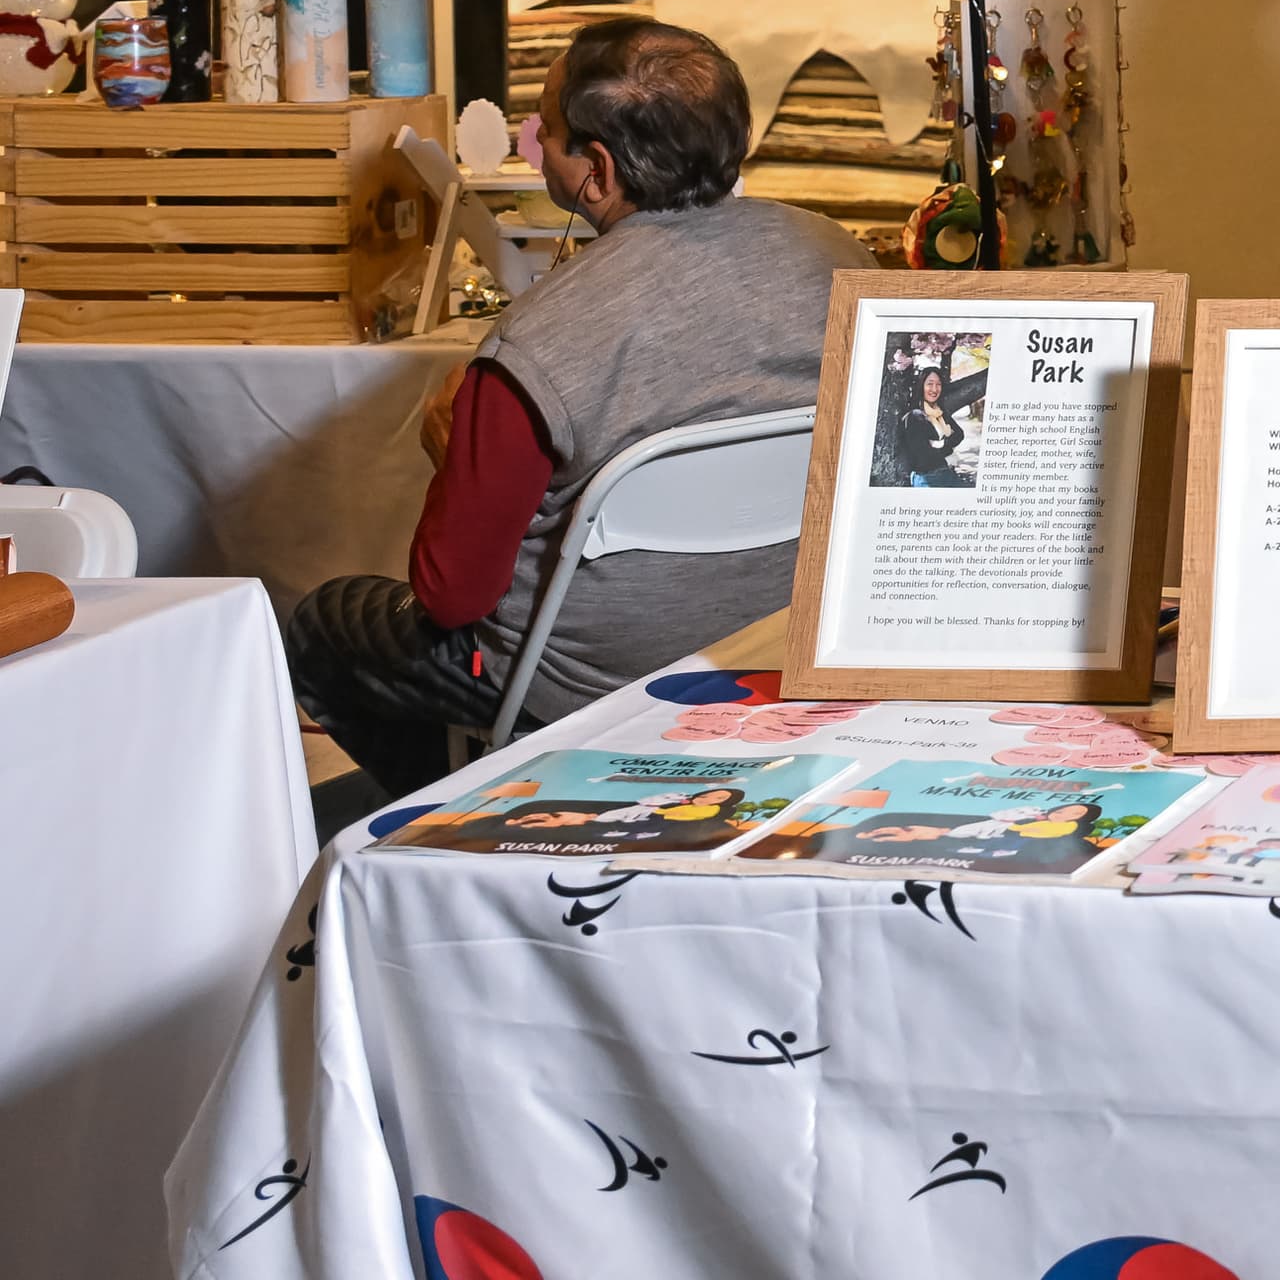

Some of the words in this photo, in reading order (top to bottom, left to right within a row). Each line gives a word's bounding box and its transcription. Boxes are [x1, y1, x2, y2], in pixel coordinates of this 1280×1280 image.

[1027, 329, 1093, 354] Susan
[1031, 359, 1084, 383] Park
[982, 473, 1030, 481] community
[1033, 473, 1069, 481] member.
[870, 592, 886, 600] and
[889, 592, 938, 600] connection.
[873, 616, 895, 627] hope
[897, 618, 913, 626] you
[915, 616, 931, 624] will
[934, 616, 945, 624] be
[947, 616, 980, 625] blessed.
[984, 616, 1015, 625] Thanks
[1017, 616, 1030, 626] for
[1032, 617, 1069, 628] stopping
[1072, 616, 1086, 628] by!
[903, 716, 970, 726] VENMO
[616, 767, 696, 776] SENTIR
[698, 769, 740, 777] LOS
[1010, 768, 1077, 780] HOW
[966, 776, 1092, 792] PUPPIES
[919, 785, 1001, 799] MAKE
[1001, 789, 1043, 801] ME
[1044, 792, 1105, 804] FEEL
[494, 842, 561, 852] SUSAN
[561, 843, 619, 853] PARK
[846, 855, 916, 865] SUSAN
[914, 857, 975, 868] PARK
